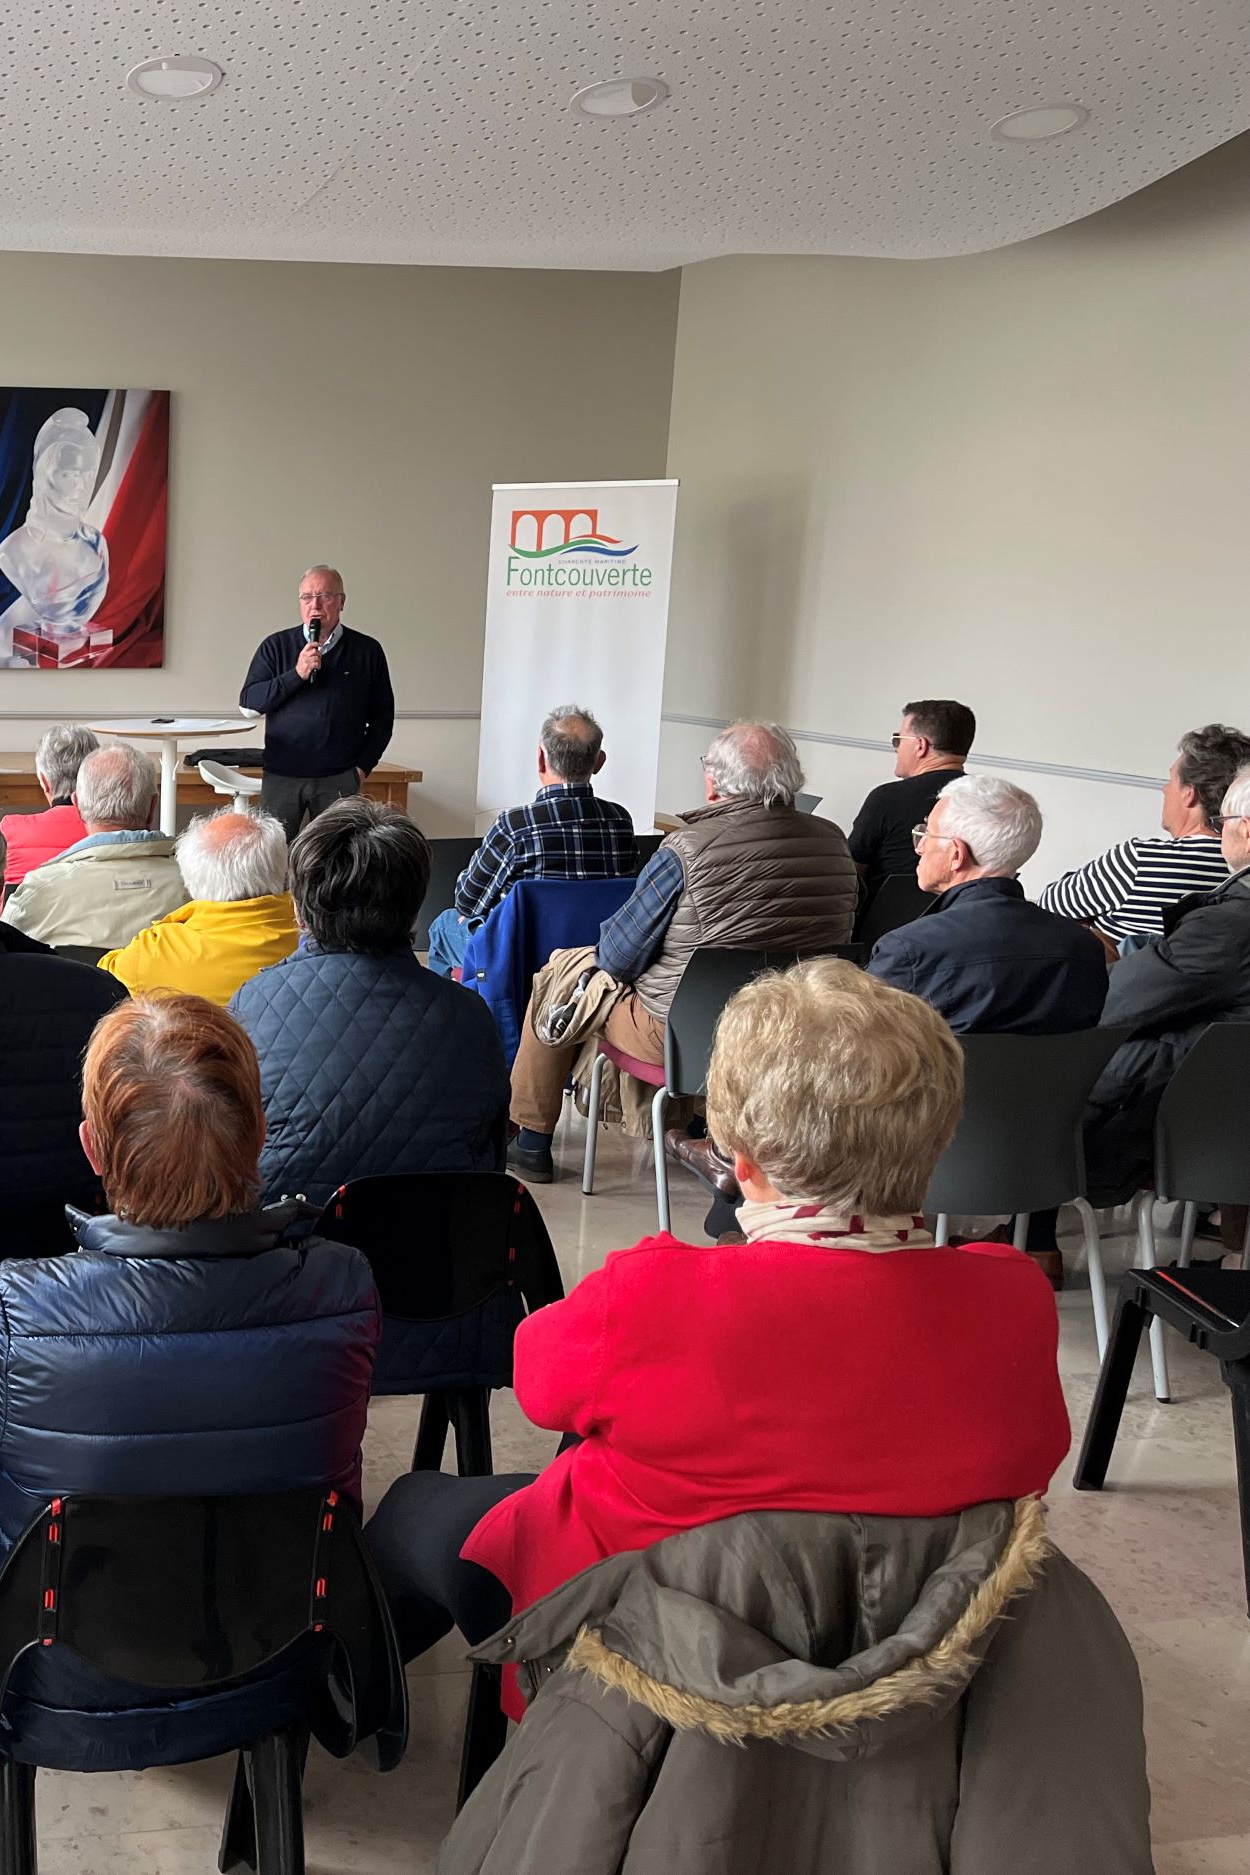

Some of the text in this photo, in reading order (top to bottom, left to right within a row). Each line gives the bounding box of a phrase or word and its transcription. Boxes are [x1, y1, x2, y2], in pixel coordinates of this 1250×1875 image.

[506, 556, 652, 587] Fontcouverte
[506, 588, 651, 599] entre nature et patrimoine
